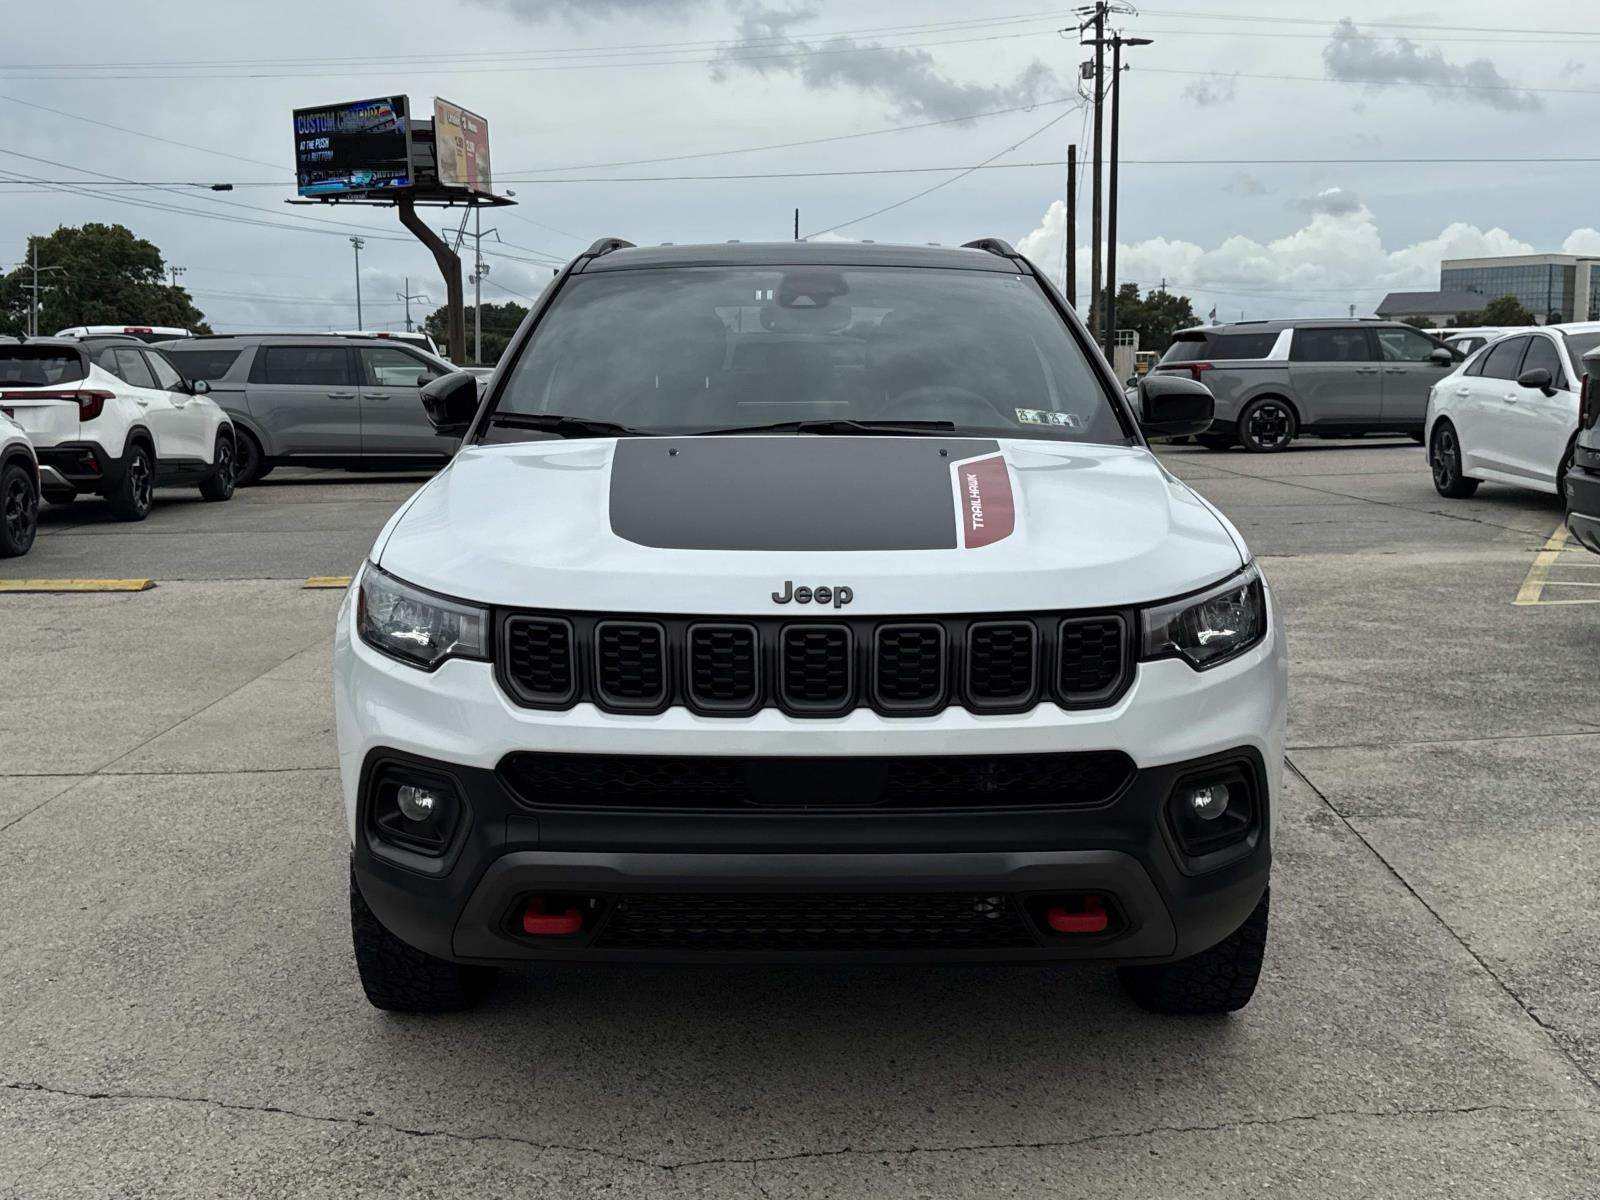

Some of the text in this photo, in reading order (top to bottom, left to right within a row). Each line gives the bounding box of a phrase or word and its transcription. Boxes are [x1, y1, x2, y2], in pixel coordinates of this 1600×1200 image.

[298, 111, 335, 134] CUSTOM
[966, 473, 985, 531] TRAILHAWK
[771, 580, 854, 609] Jeep
